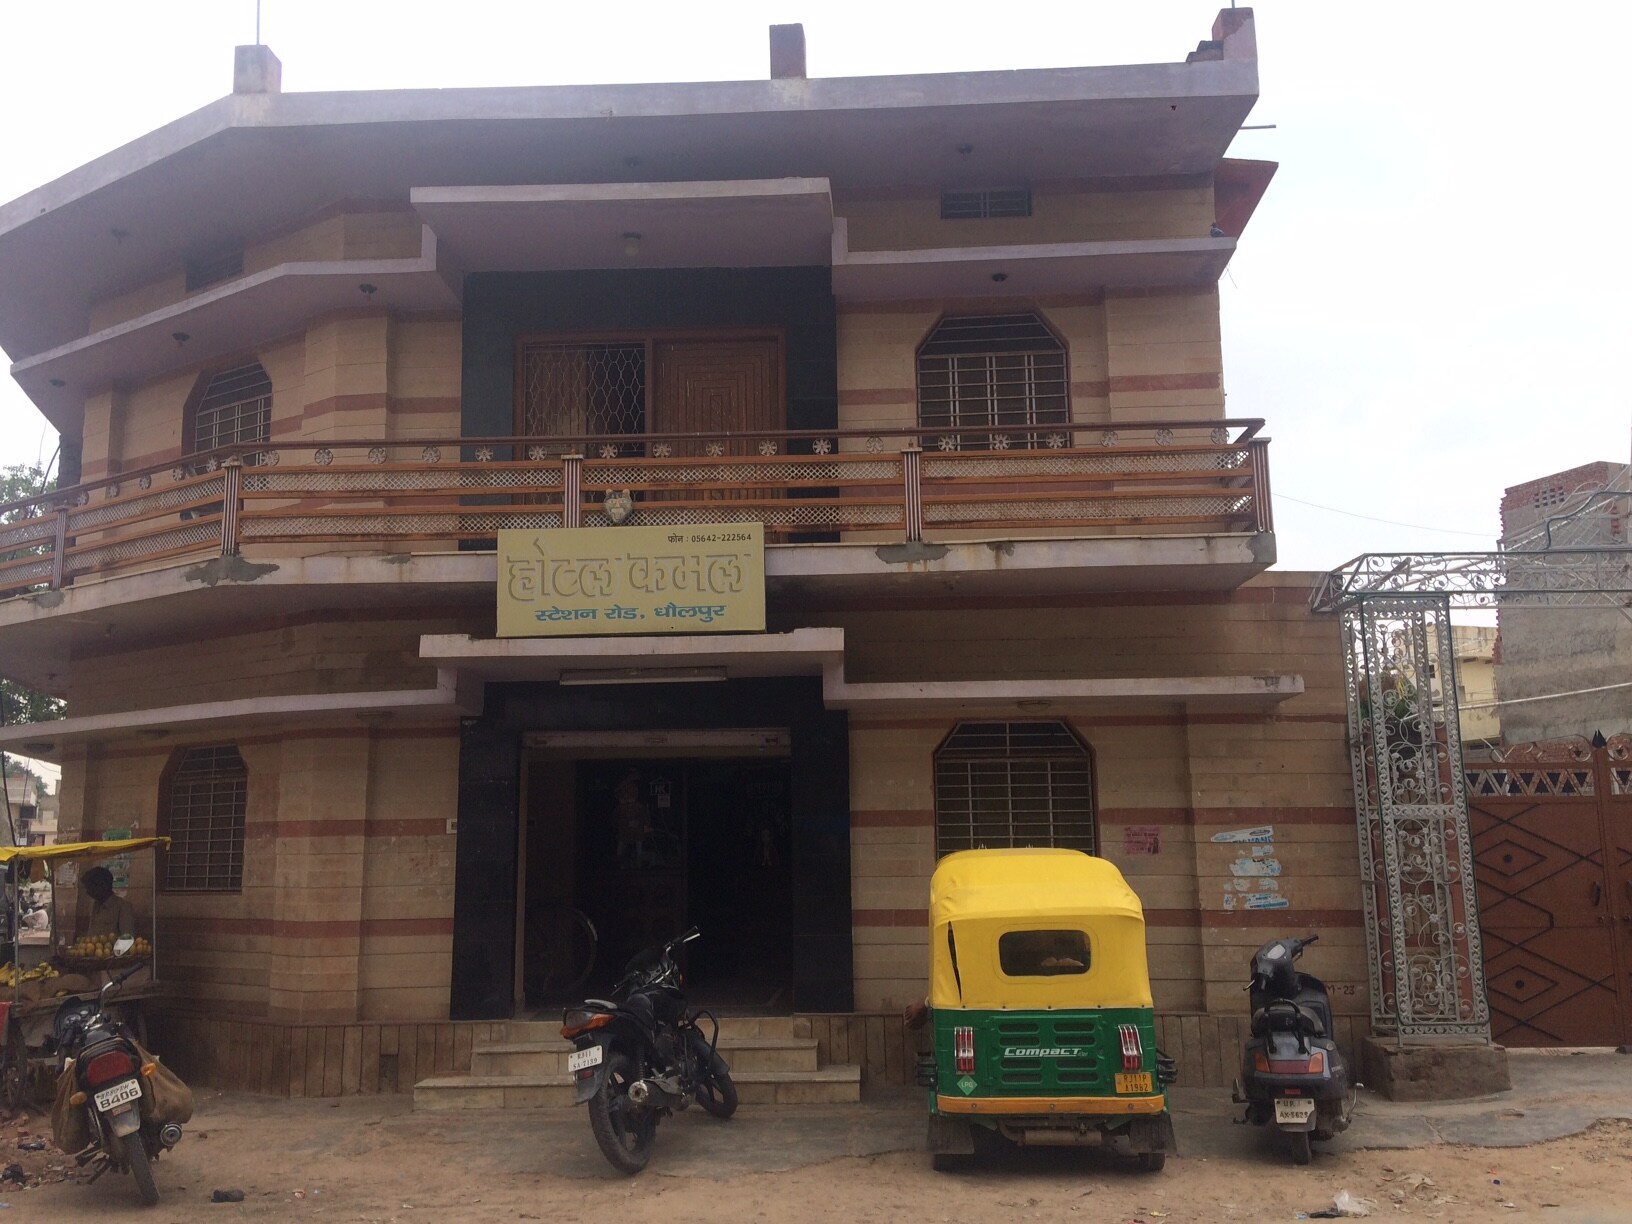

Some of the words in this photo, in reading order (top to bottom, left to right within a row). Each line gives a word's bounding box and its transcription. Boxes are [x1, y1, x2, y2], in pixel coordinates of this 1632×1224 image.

[668, 533, 684, 543] फोन
[691, 533, 752, 543] 05642-222564
[507, 537, 622, 602] होटल
[627, 552, 752, 595] कमल
[535, 606, 598, 622] स्टेशन
[604, 604, 645, 620] रोड,
[654, 602, 727, 623] धौलपुर
[1123, 1074, 1147, 1083] RJ11P
[100, 1087, 138, 1109] 8406
